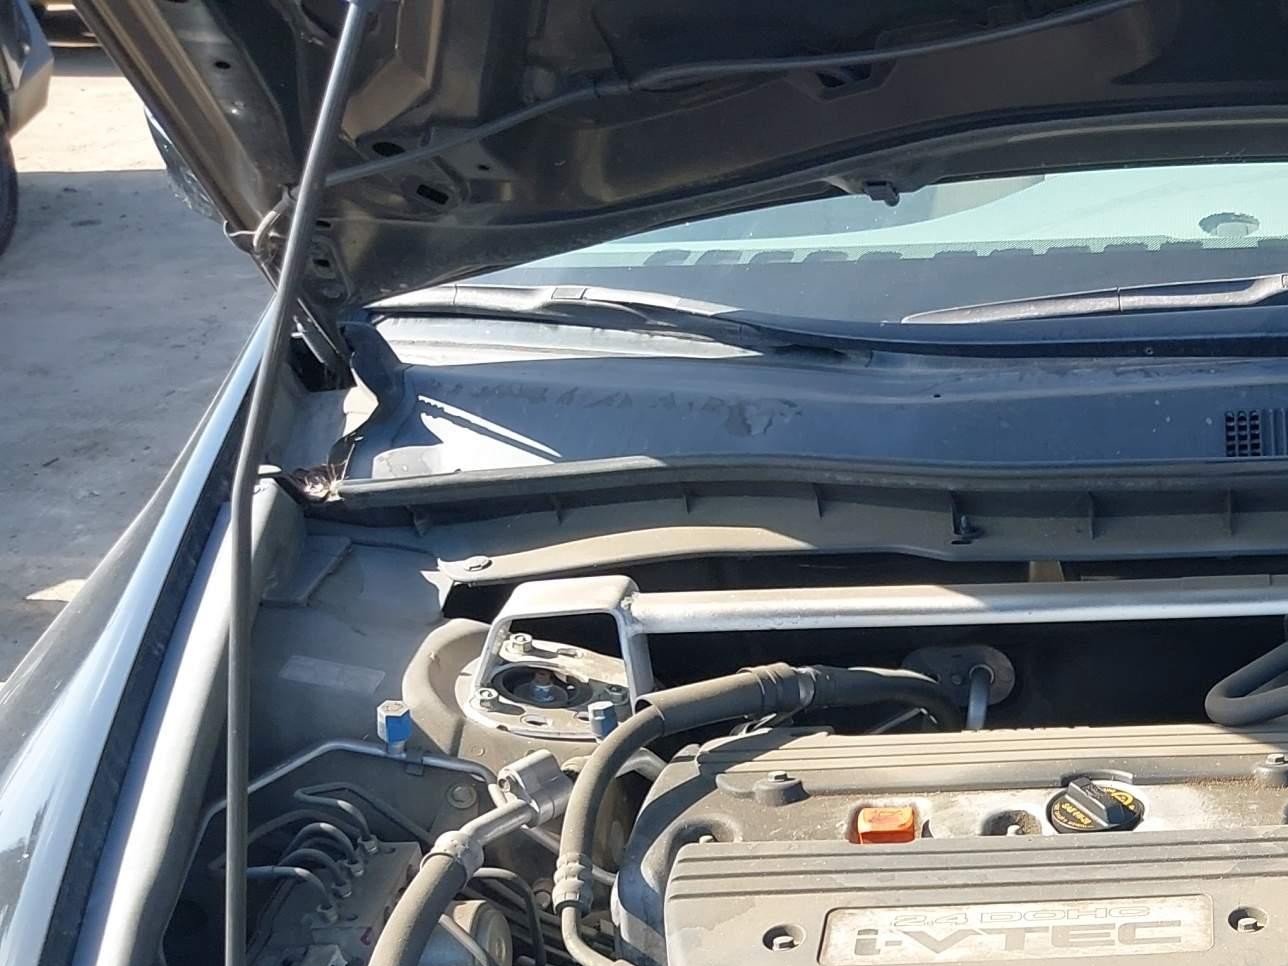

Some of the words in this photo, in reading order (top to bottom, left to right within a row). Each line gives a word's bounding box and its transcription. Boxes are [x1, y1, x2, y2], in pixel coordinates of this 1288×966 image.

[893, 912, 969, 927] 2.4
[980, 905, 1151, 924] DOHC
[854, 919, 1182, 956] i-VTEC
